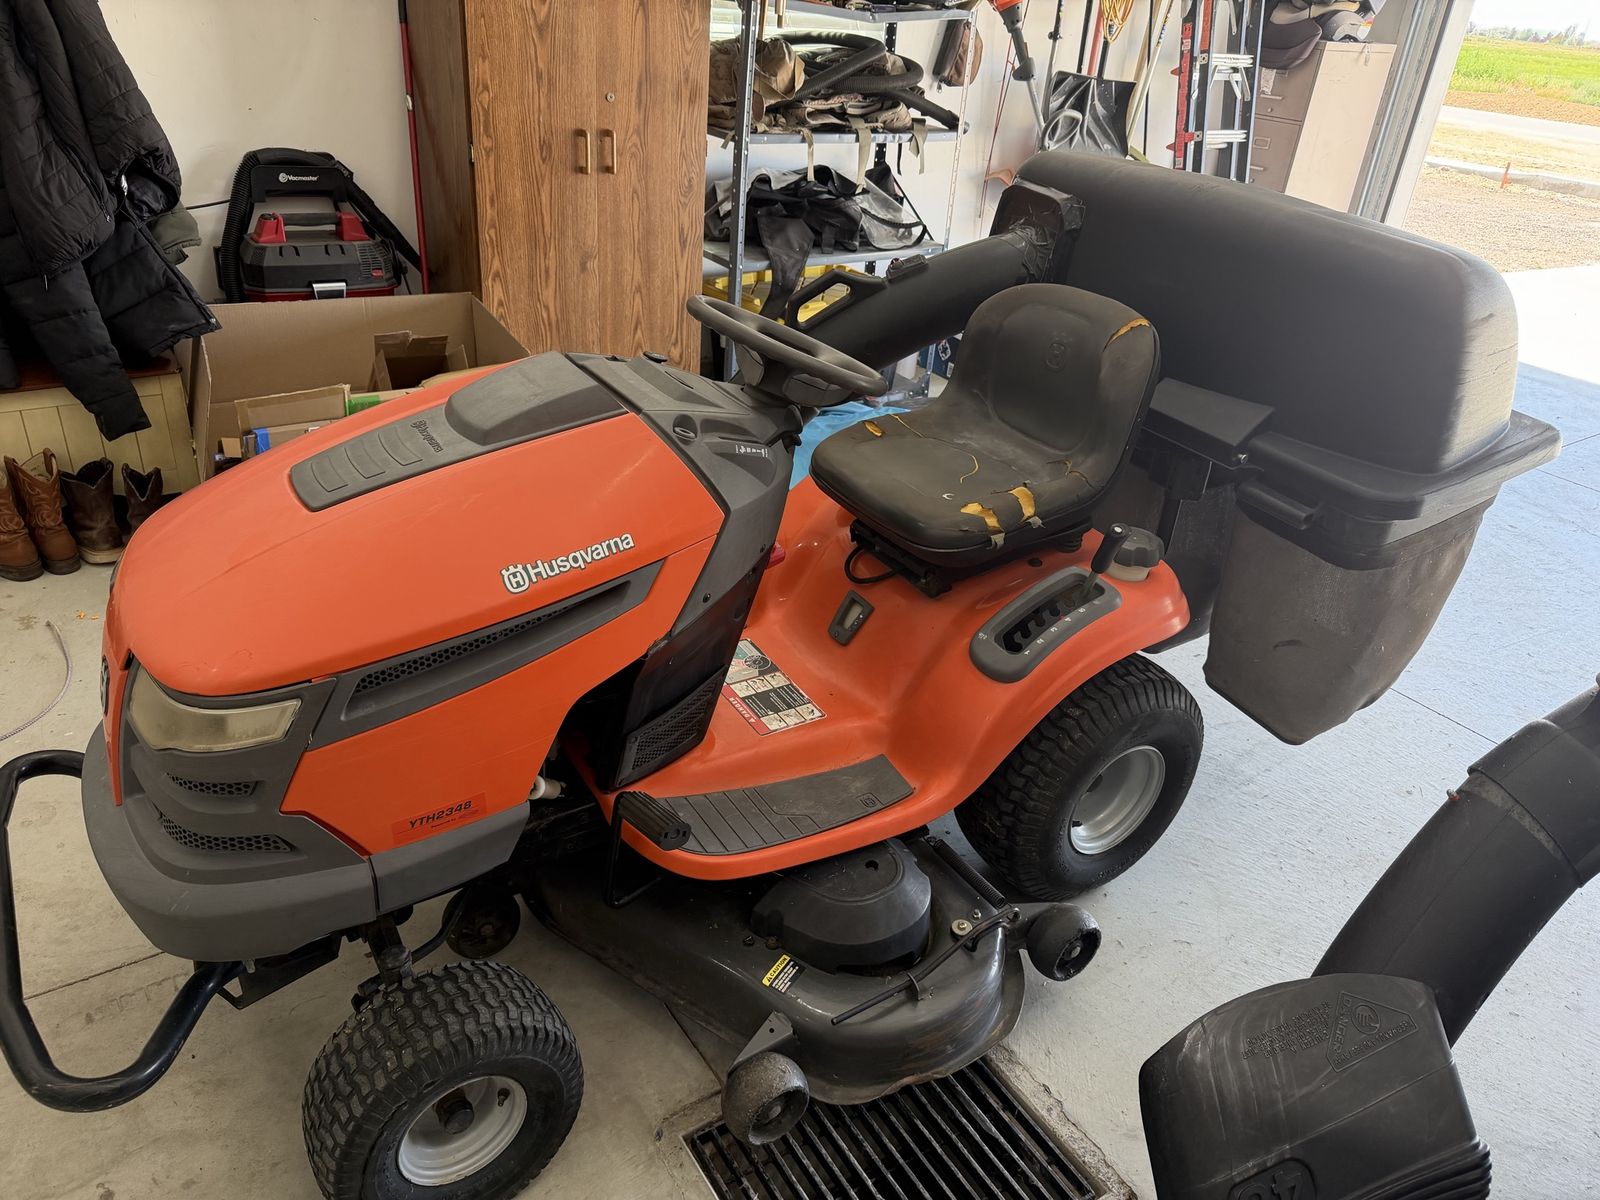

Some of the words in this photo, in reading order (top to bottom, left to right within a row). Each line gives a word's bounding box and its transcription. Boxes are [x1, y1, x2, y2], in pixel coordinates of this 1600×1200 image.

[526, 533, 635, 583] Husqvarna
[409, 800, 472, 828] YTH2348
[770, 957, 788, 977] CAUTION
